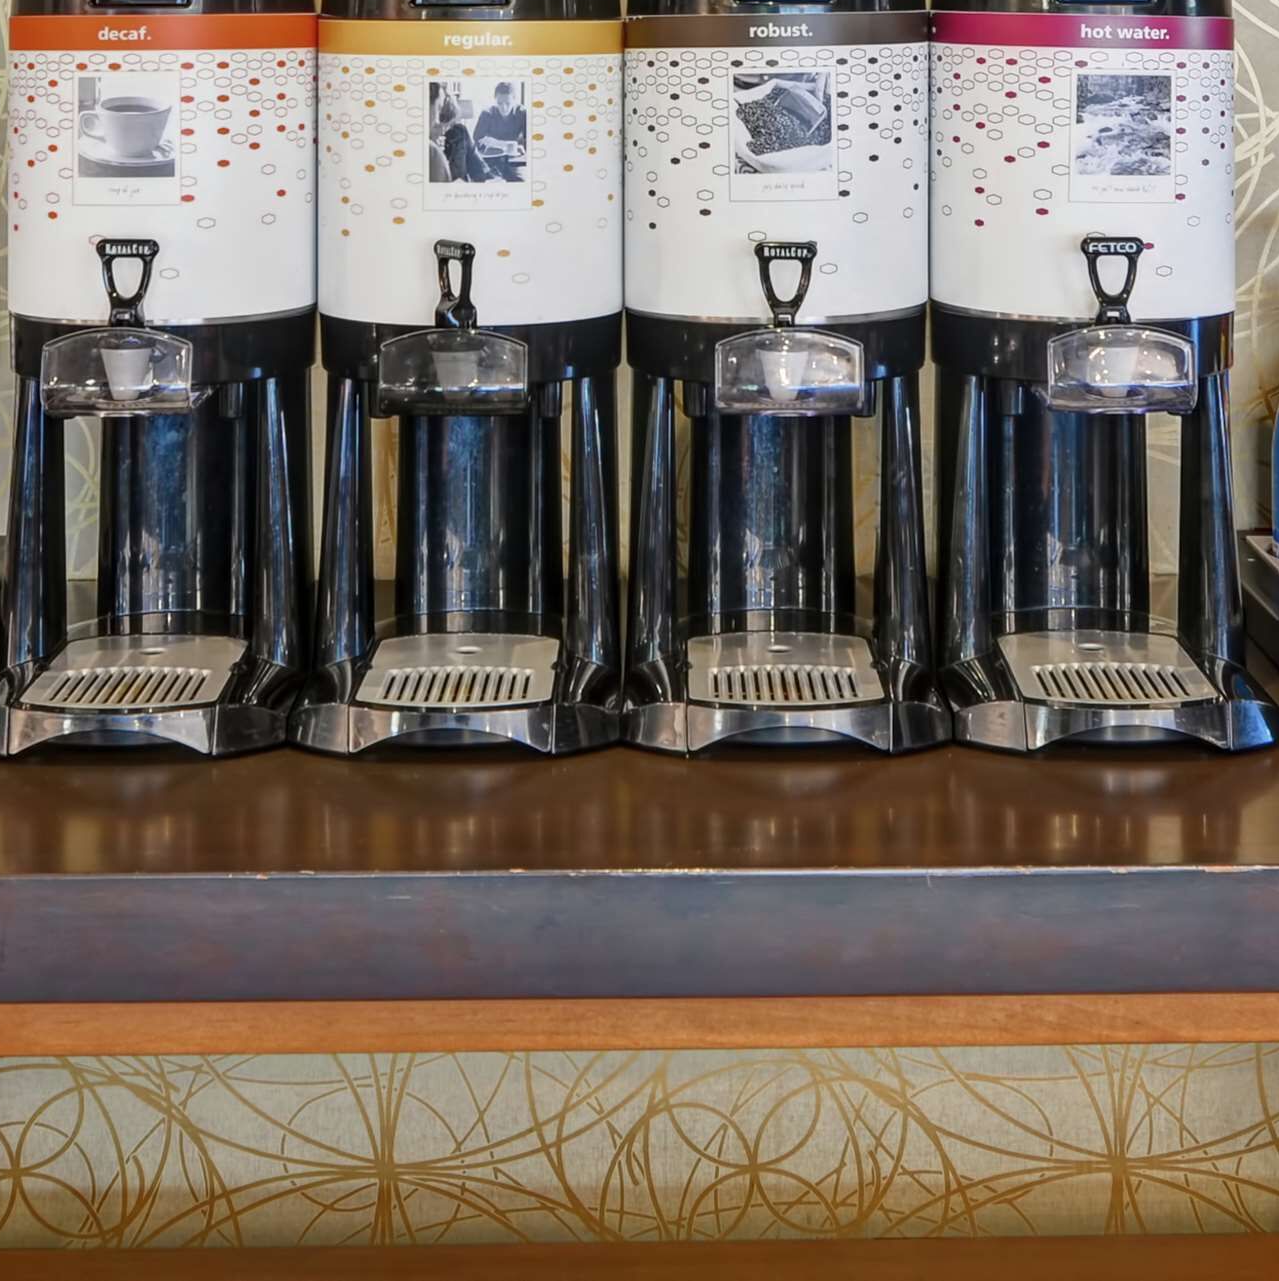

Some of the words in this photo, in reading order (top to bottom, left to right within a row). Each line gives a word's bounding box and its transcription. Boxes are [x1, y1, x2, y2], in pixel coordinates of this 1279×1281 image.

[98, 26, 152, 40] decaf.
[749, 22, 813, 38] robust.
[1080, 24, 1113, 39] hot
[1117, 25, 1170, 40] water.
[443, 32, 512, 49] regular.
[1088, 242, 1137, 253] FETCO
